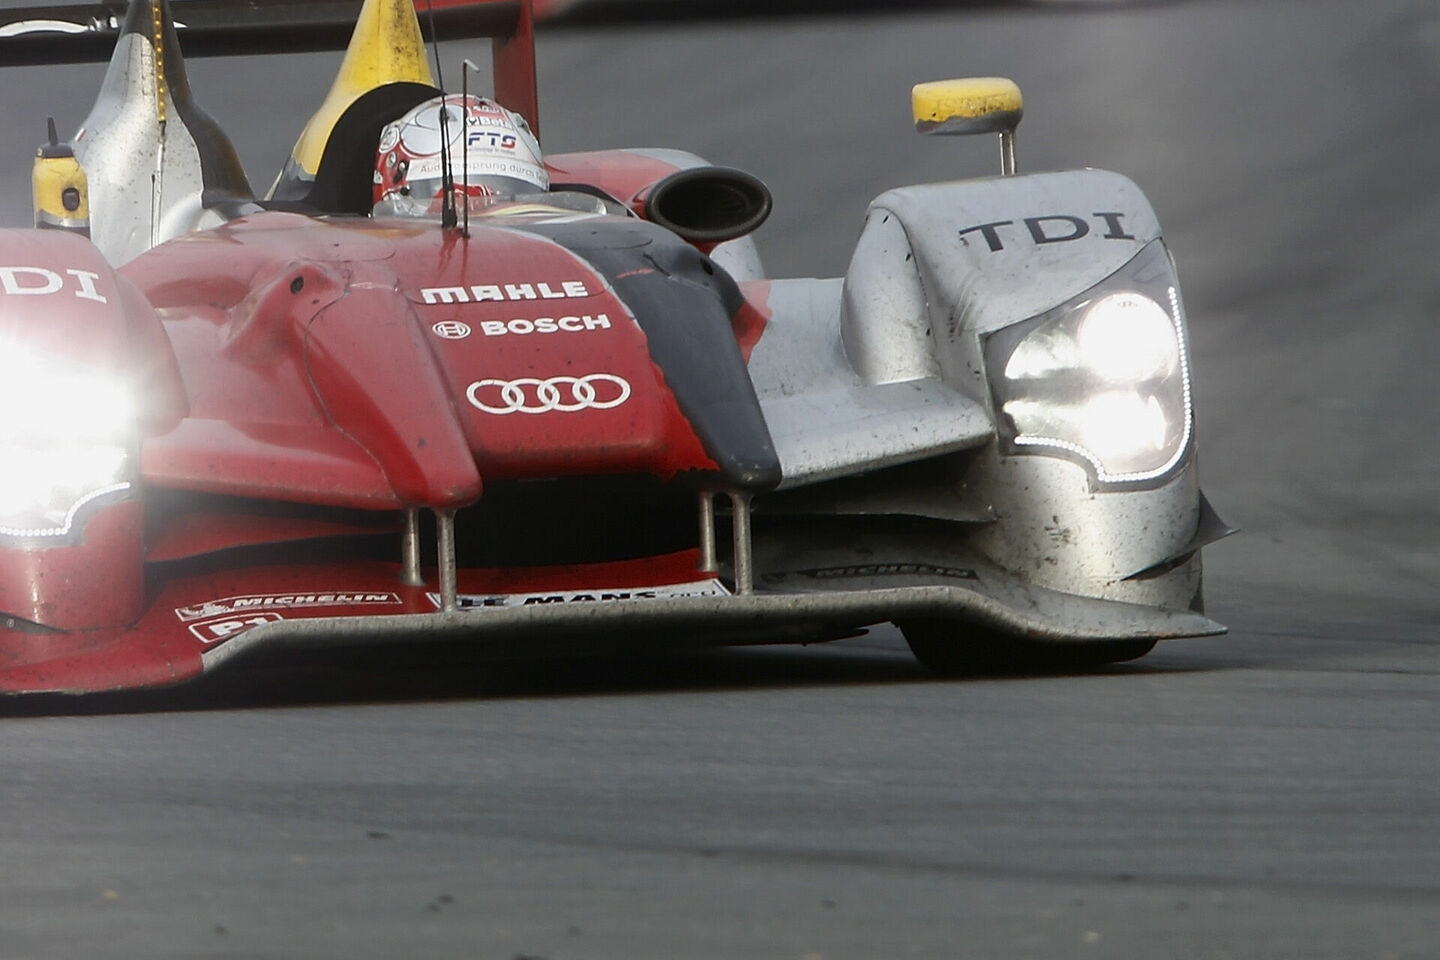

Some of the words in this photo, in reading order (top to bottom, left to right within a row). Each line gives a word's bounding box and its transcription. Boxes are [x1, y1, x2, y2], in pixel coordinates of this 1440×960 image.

[468, 132, 517, 149] FTS
[958, 212, 1136, 253] TDI
[420, 281, 589, 304] MAHLE
[480, 314, 612, 336] BOSCH
[233, 594, 389, 609] MICHELIN
[208, 616, 271, 637] P1
